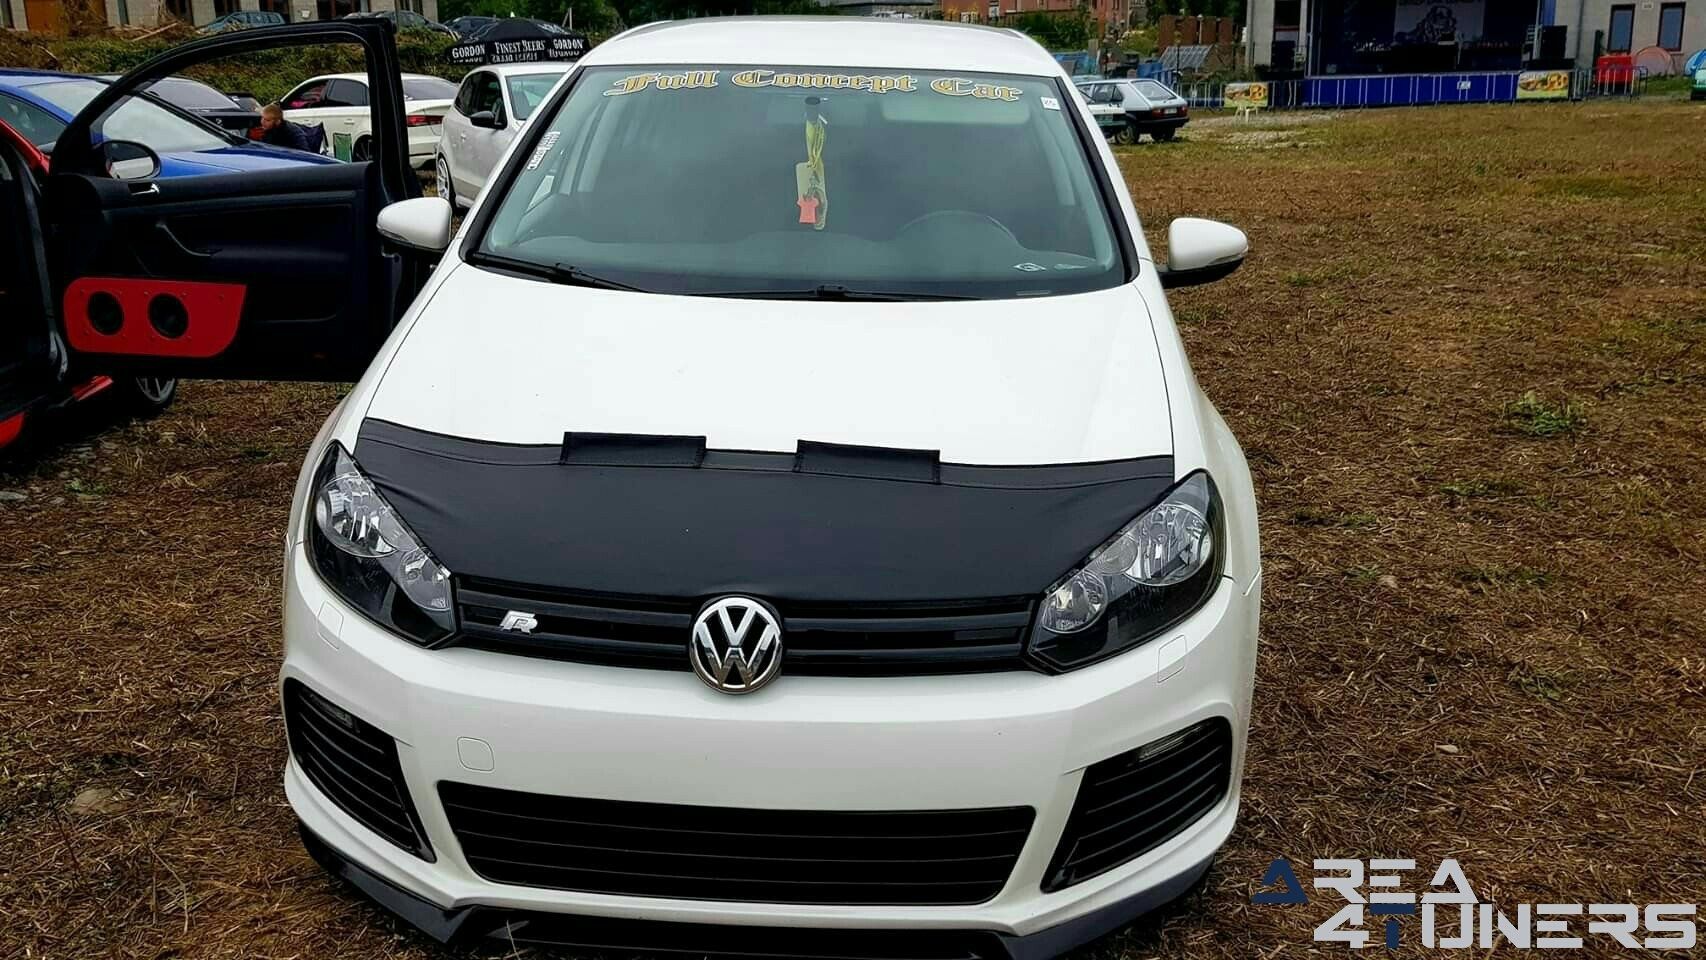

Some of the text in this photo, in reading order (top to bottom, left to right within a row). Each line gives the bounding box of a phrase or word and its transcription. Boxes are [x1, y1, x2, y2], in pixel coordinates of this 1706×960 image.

[452, 44, 485, 58] GORDON
[494, 41, 521, 54] FINEST
[553, 39, 584, 49] GORDON
[603, 70, 1023, 102] Full Concept Car
[500, 610, 538, 635] R
[694, 600, 780, 691] VW
